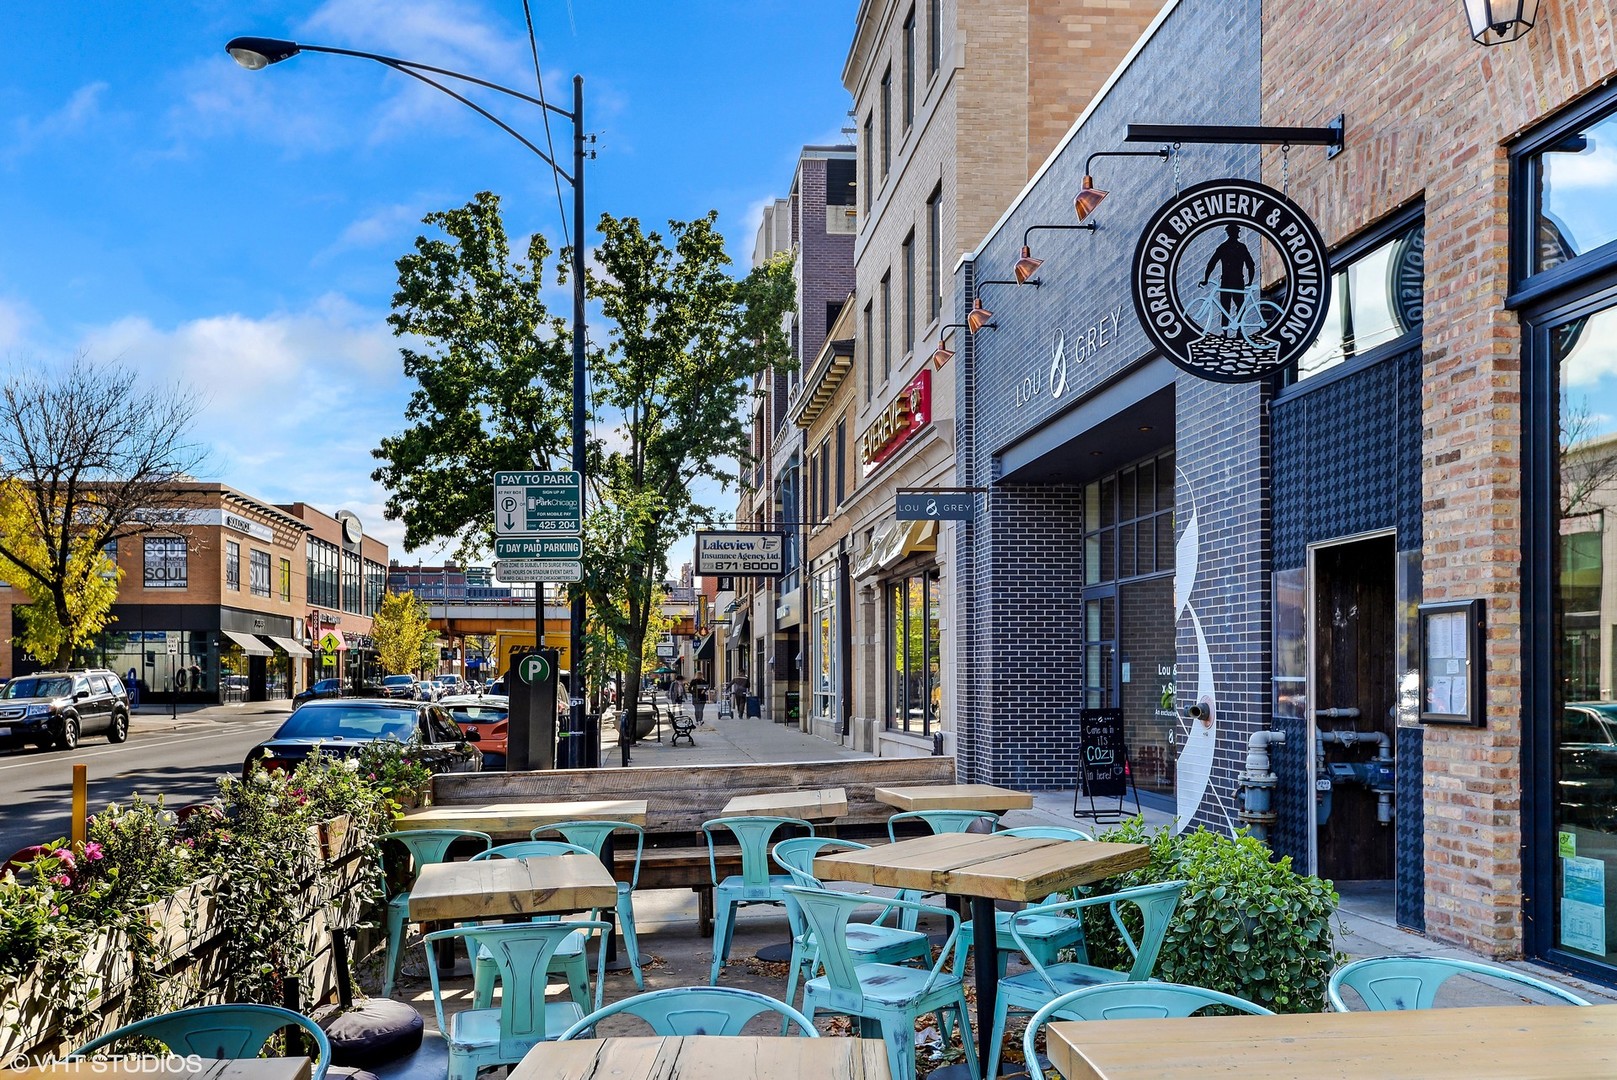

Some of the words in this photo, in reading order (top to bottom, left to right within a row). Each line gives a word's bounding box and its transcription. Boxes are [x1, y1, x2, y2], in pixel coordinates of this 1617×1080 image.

[1146, 232, 1182, 339] CORRIDOR
[1168, 193, 1265, 235] BREWERY
[1265, 208, 1282, 229] &
[1279, 223, 1318, 345] PROVISIONS
[1016, 368, 1041, 408] LOU
[1049, 327, 1071, 399] &
[1075, 305, 1122, 364] GREY
[860, 393, 910, 464] EVEREVE
[500, 475, 522, 485] PAY
[524, 475, 540, 485] TO
[543, 474, 574, 485] PARK
[536, 499, 577, 507] ParkChicago
[926, 498, 940, 516] &
[558, 521, 576, 529] 204
[145, 544, 186, 557] SOUL
[499, 544, 504, 553] 7
[506, 544, 521, 552] DAY
[523, 544, 542, 552] PAID
[544, 543, 579, 552] PARKING
[703, 540, 756, 550] Lakeview
[737, 553, 765, 561] Agency,
[145, 568, 186, 579] SOUL
[1158, 664, 1170, 675] Lou
[1162, 685, 1166, 694] x
